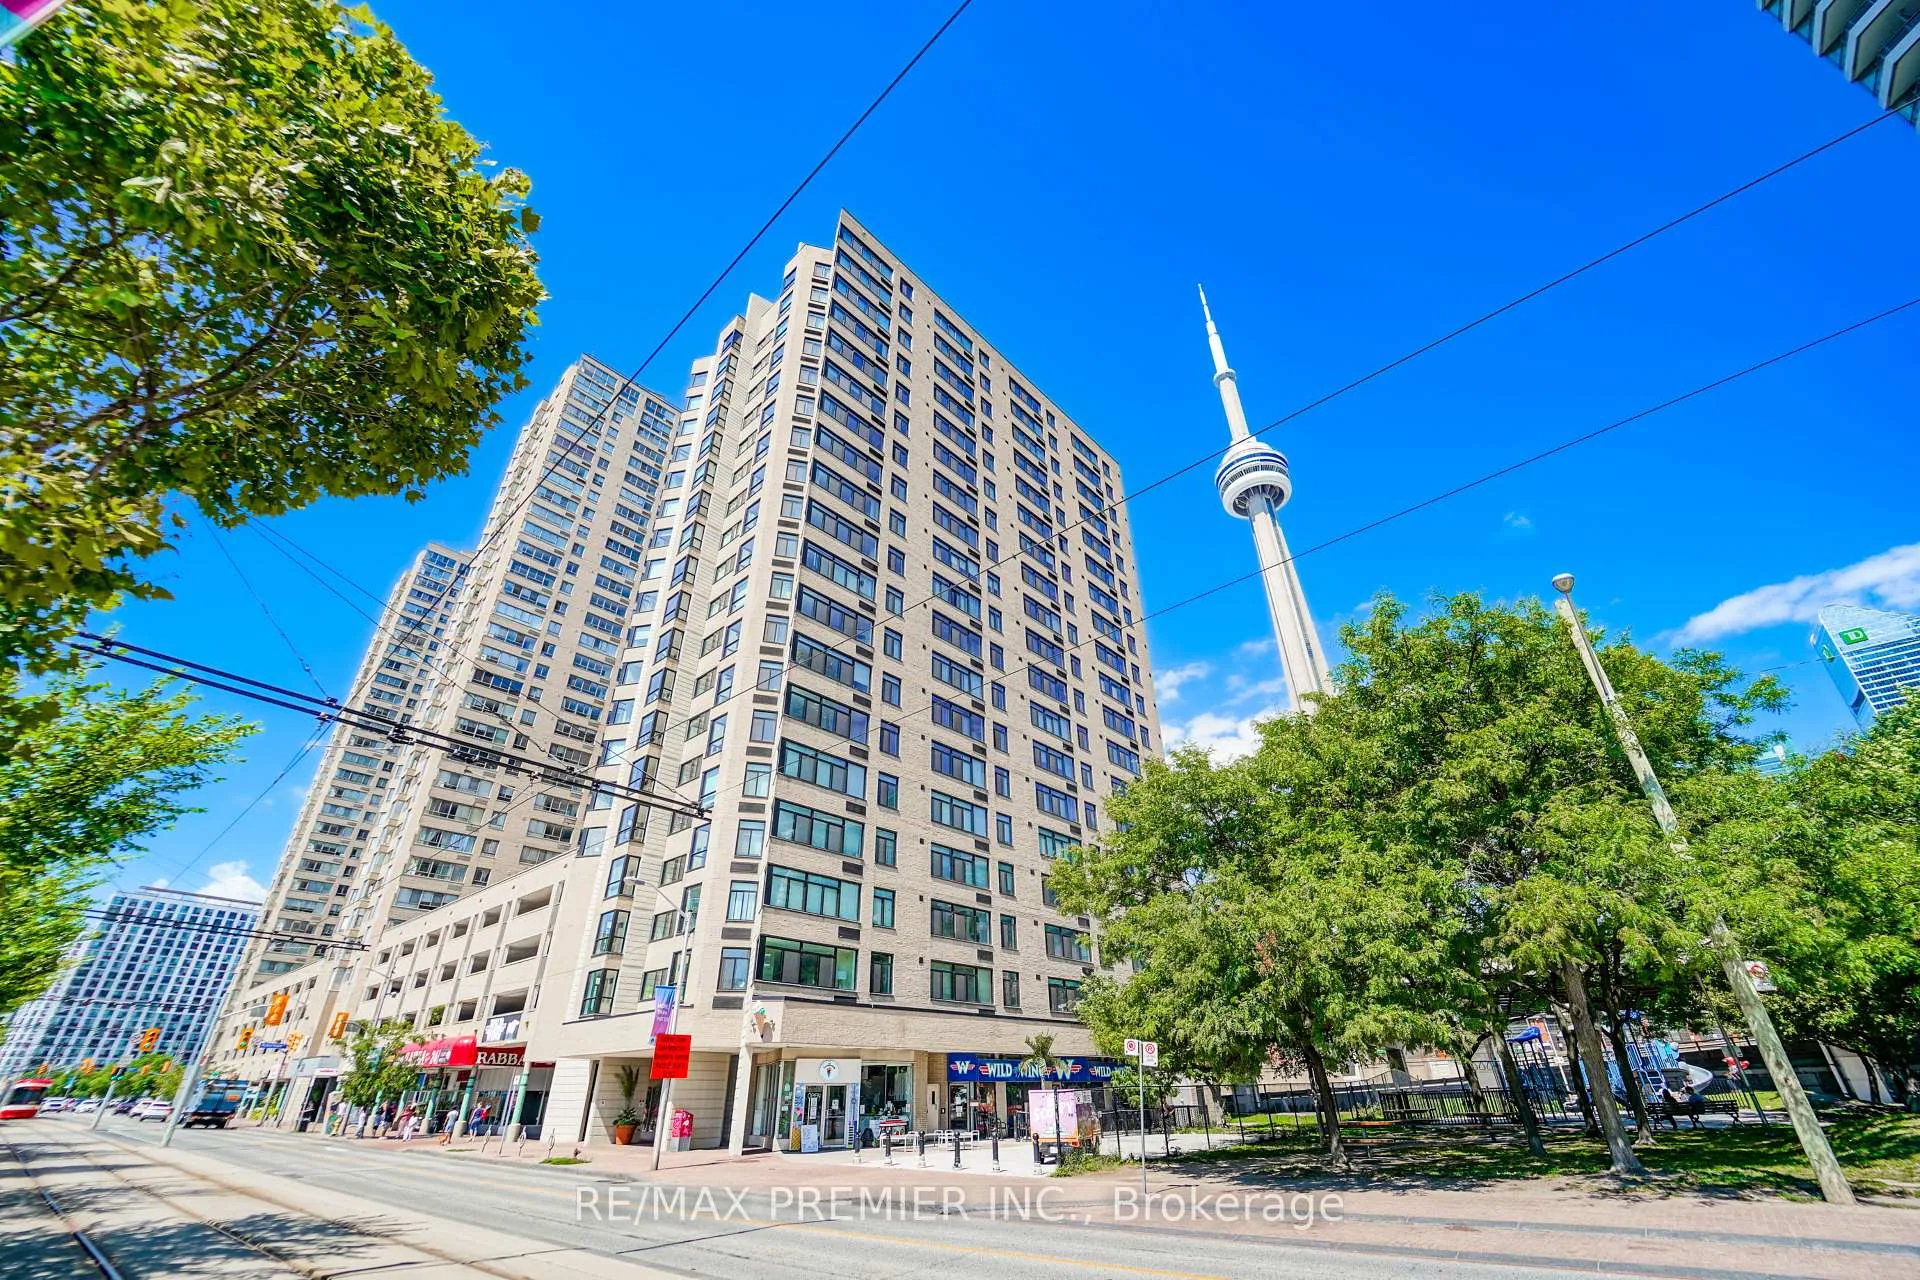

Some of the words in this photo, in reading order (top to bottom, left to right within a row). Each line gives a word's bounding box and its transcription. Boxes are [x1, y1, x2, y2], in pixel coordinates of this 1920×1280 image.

[1843, 630, 1864, 641] TD
[956, 1060, 970, 1075] W
[986, 1063, 1013, 1078] WILD
[1094, 1065, 1111, 1078] WILD
